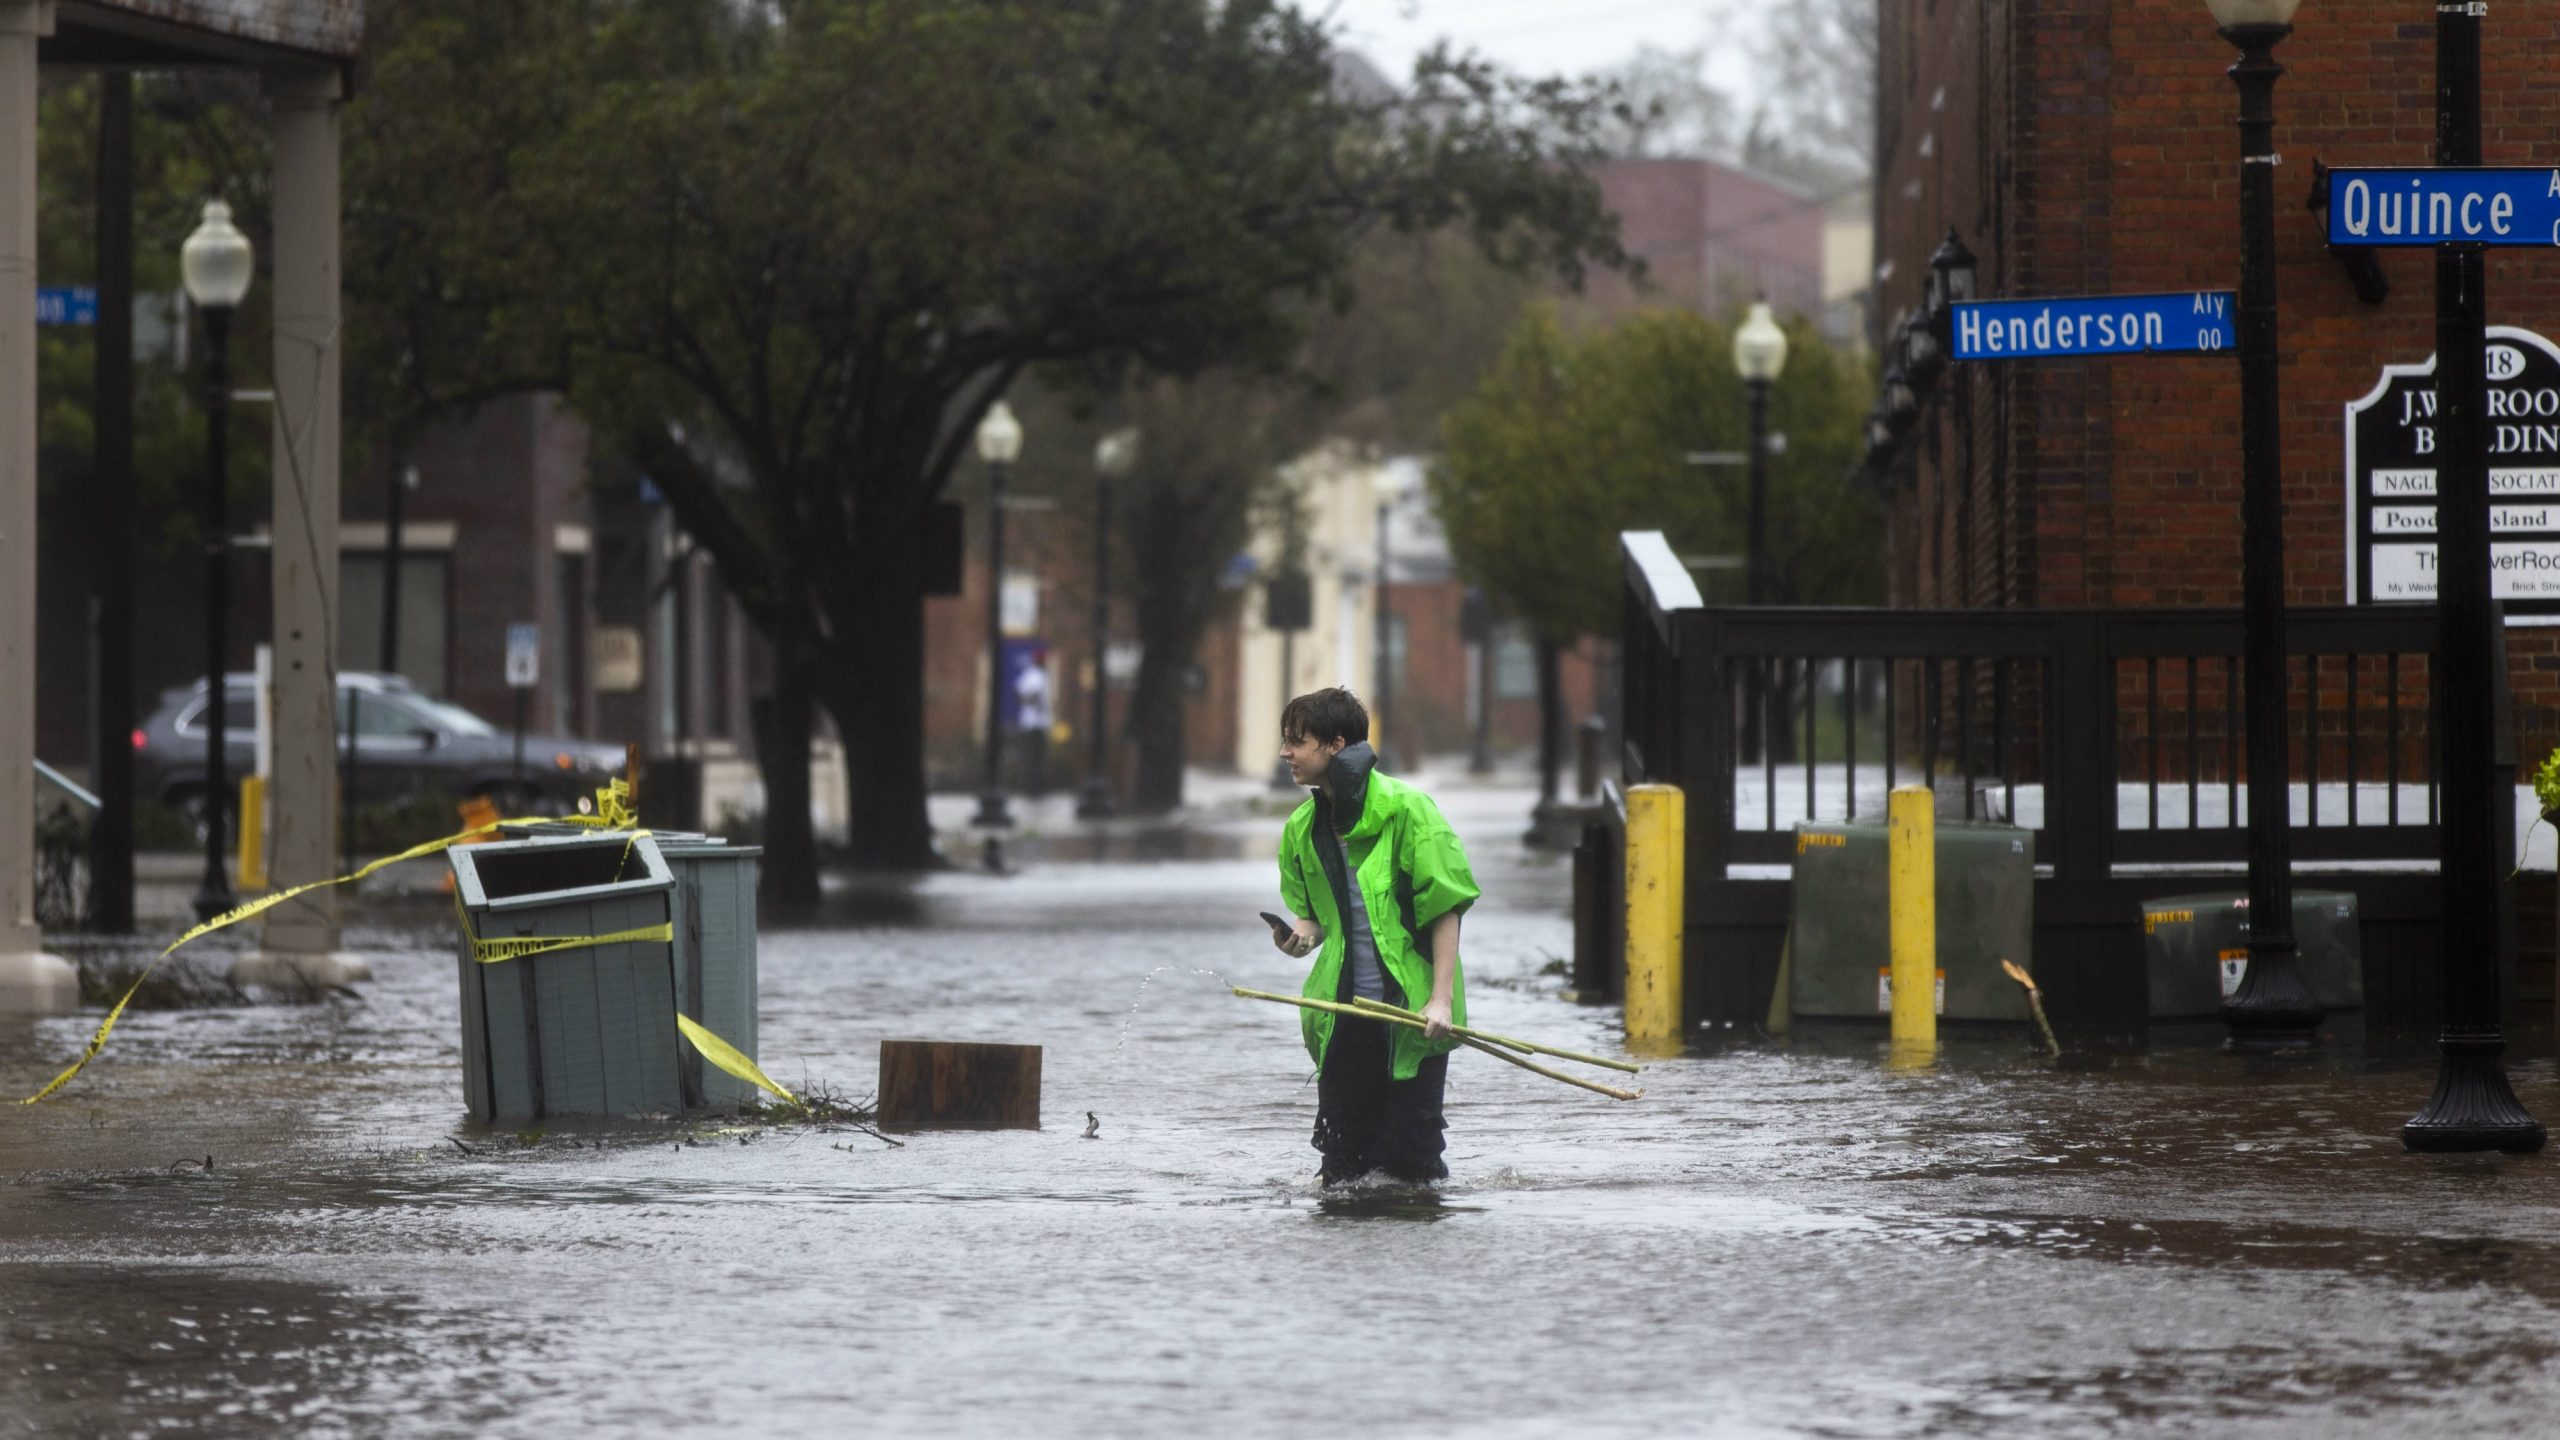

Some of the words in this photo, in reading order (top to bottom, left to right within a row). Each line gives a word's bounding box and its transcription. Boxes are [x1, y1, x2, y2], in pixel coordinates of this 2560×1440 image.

[2344, 179, 2513, 237] Quince
[2193, 293, 2224, 319] Aly
[1960, 307, 2163, 353] Henderson
[2199, 328, 2221, 351] 00
